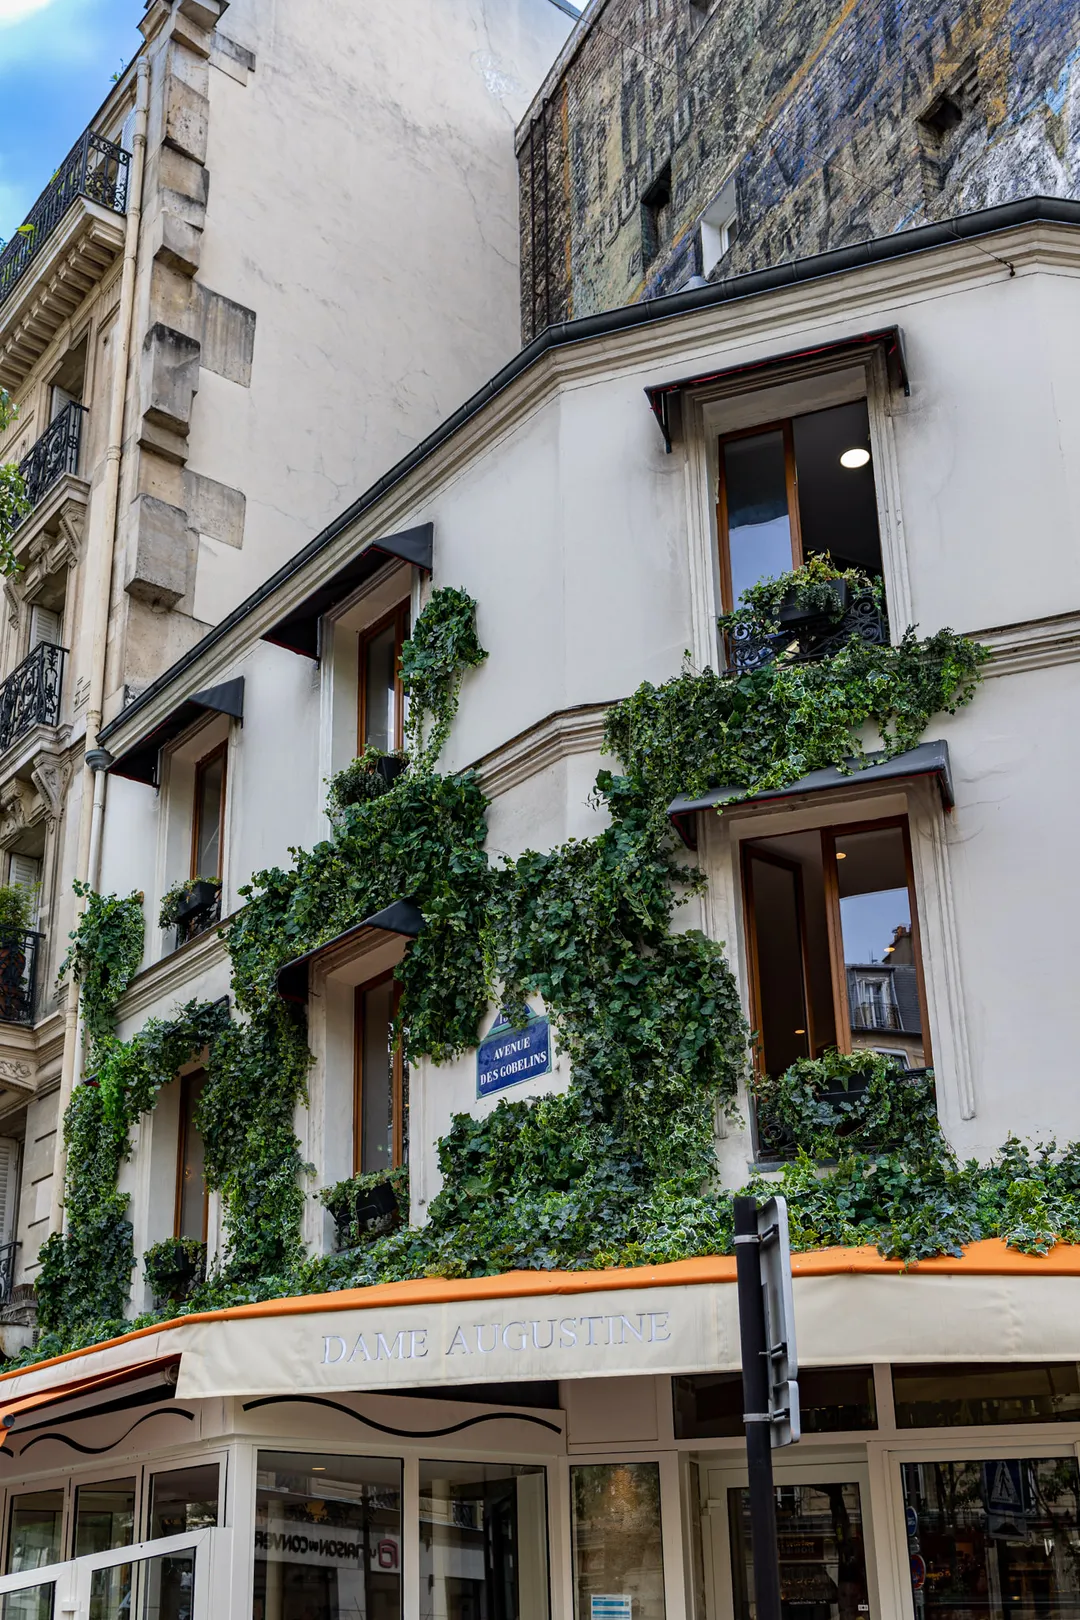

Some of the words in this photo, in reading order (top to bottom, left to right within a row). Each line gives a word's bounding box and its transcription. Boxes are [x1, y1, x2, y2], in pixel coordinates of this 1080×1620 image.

[493, 1036, 531, 1061] AVENUE
[480, 1069, 499, 1085] DES
[500, 1051, 547, 1077] GOBELINS
[320, 1328, 429, 1365] DAME
[445, 1312, 672, 1356] AUGUSTINE
